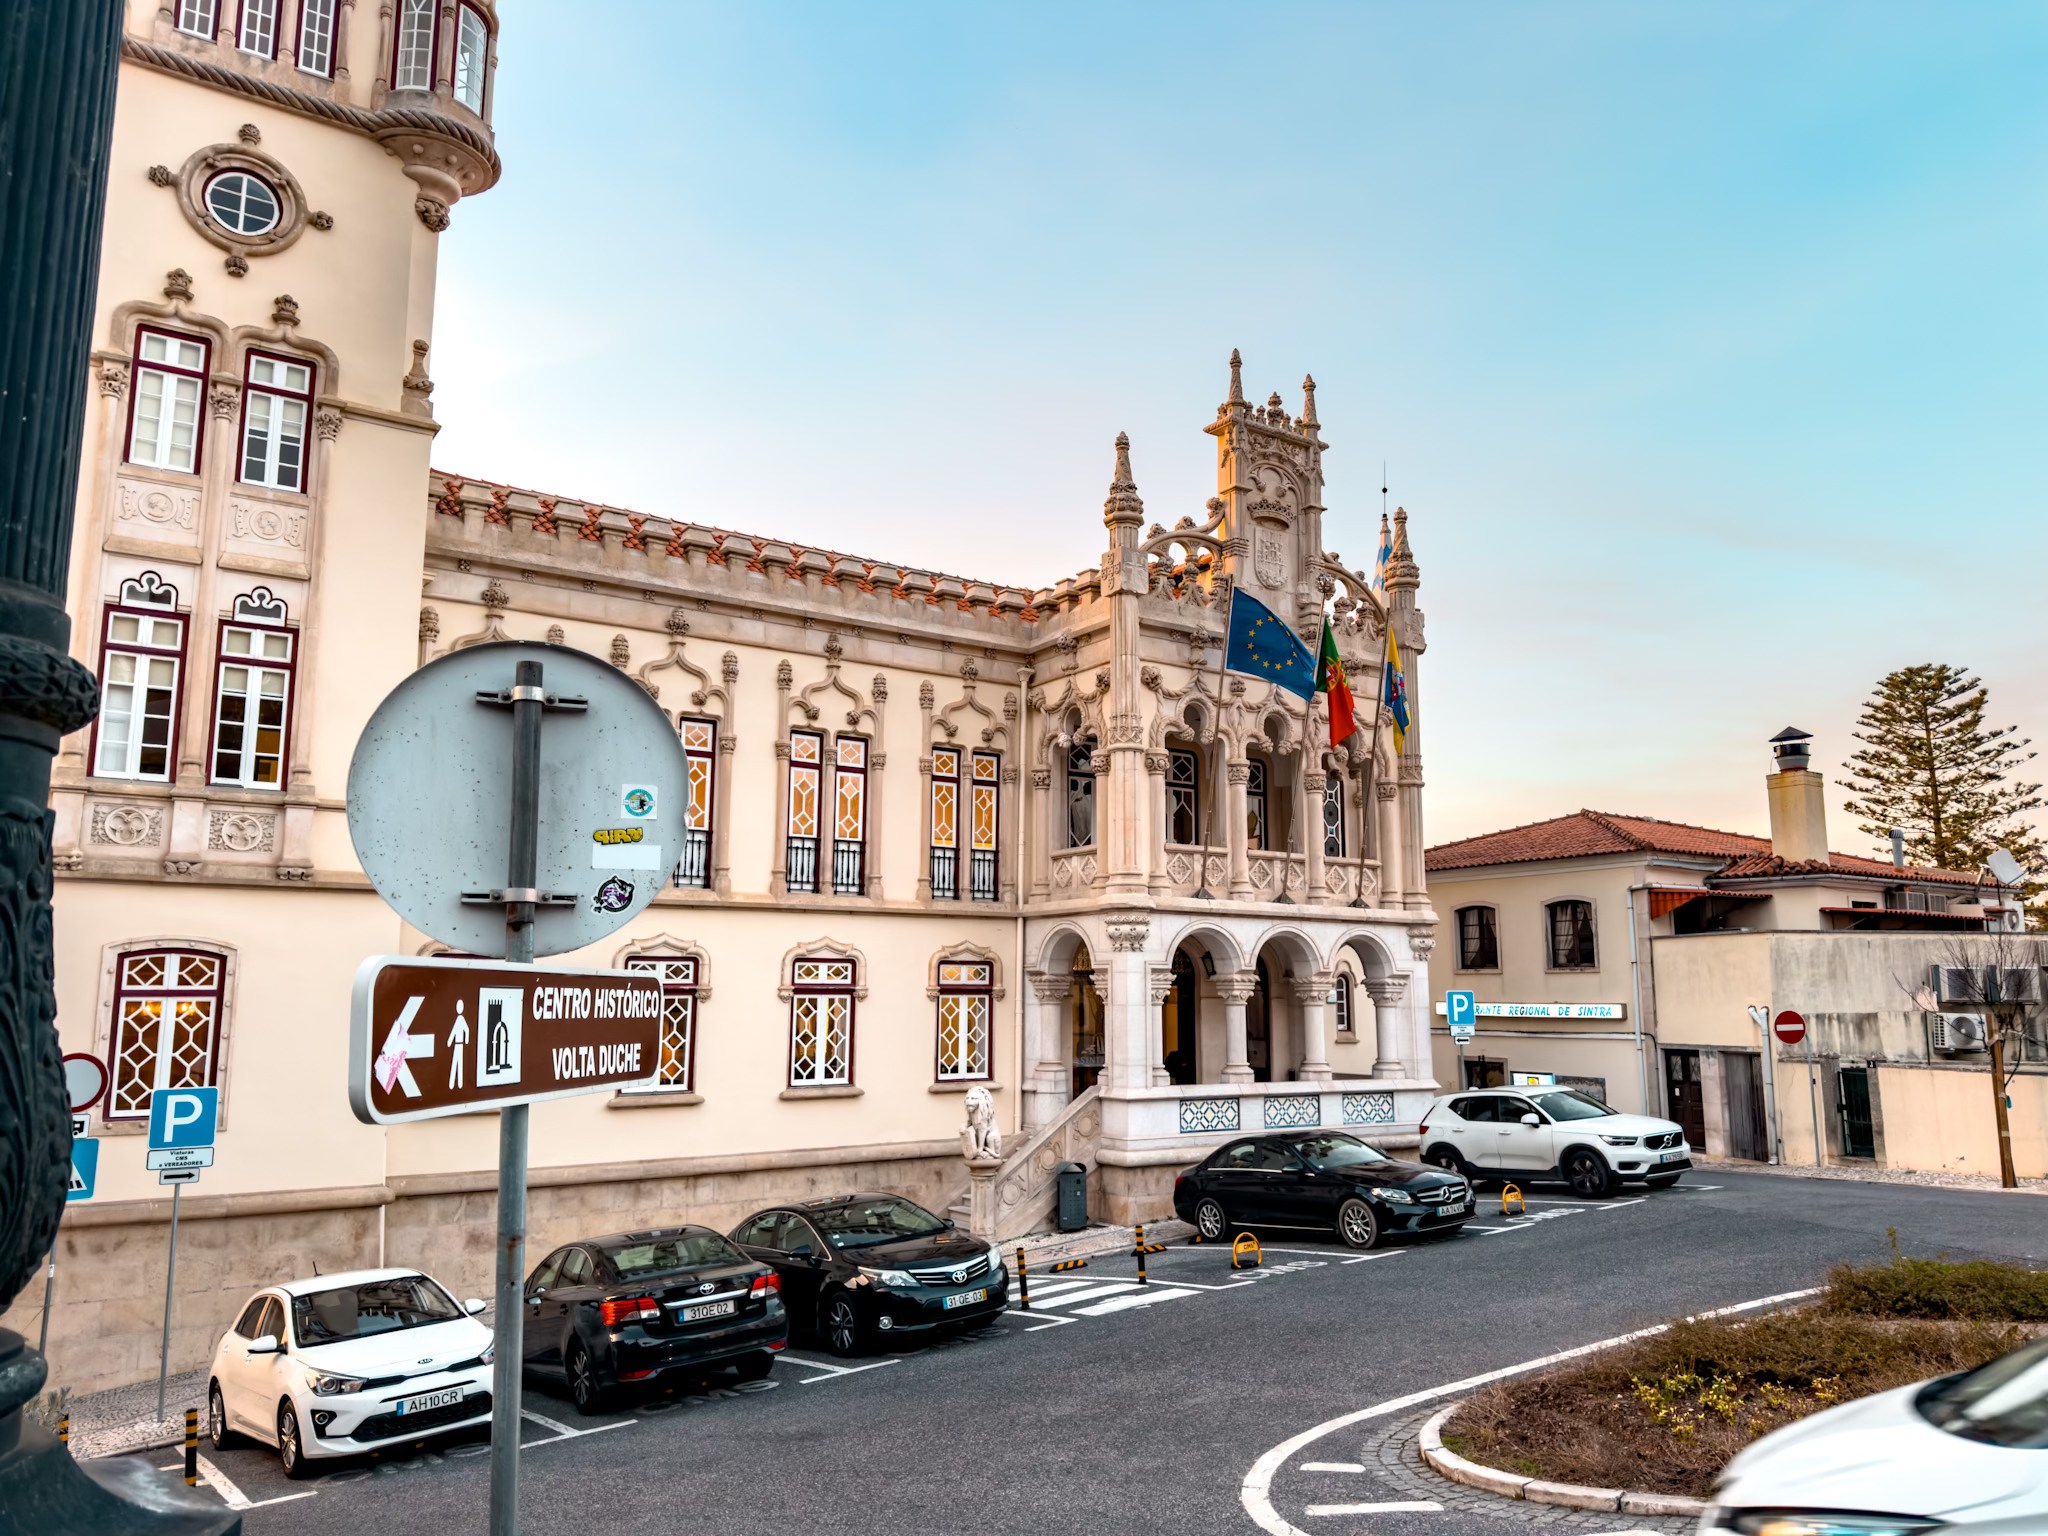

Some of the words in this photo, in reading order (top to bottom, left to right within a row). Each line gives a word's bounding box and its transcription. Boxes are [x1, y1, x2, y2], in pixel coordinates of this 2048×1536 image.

[532, 985, 591, 1020] CENTRO
[593, 982, 660, 1019] HISTÓRICO
[1452, 993, 1469, 1022] P
[1475, 1004, 1502, 1016] RANTE
[1508, 1005, 1551, 1016] REGIONAL
[1558, 1006, 1571, 1016] DE
[1577, 1006, 1613, 1017] SINTRA
[552, 1046, 597, 1080] VOLTA
[598, 1043, 642, 1075] DUCHE
[163, 1094, 203, 1143] P
[1229, 1260, 1328, 1280] CMS
